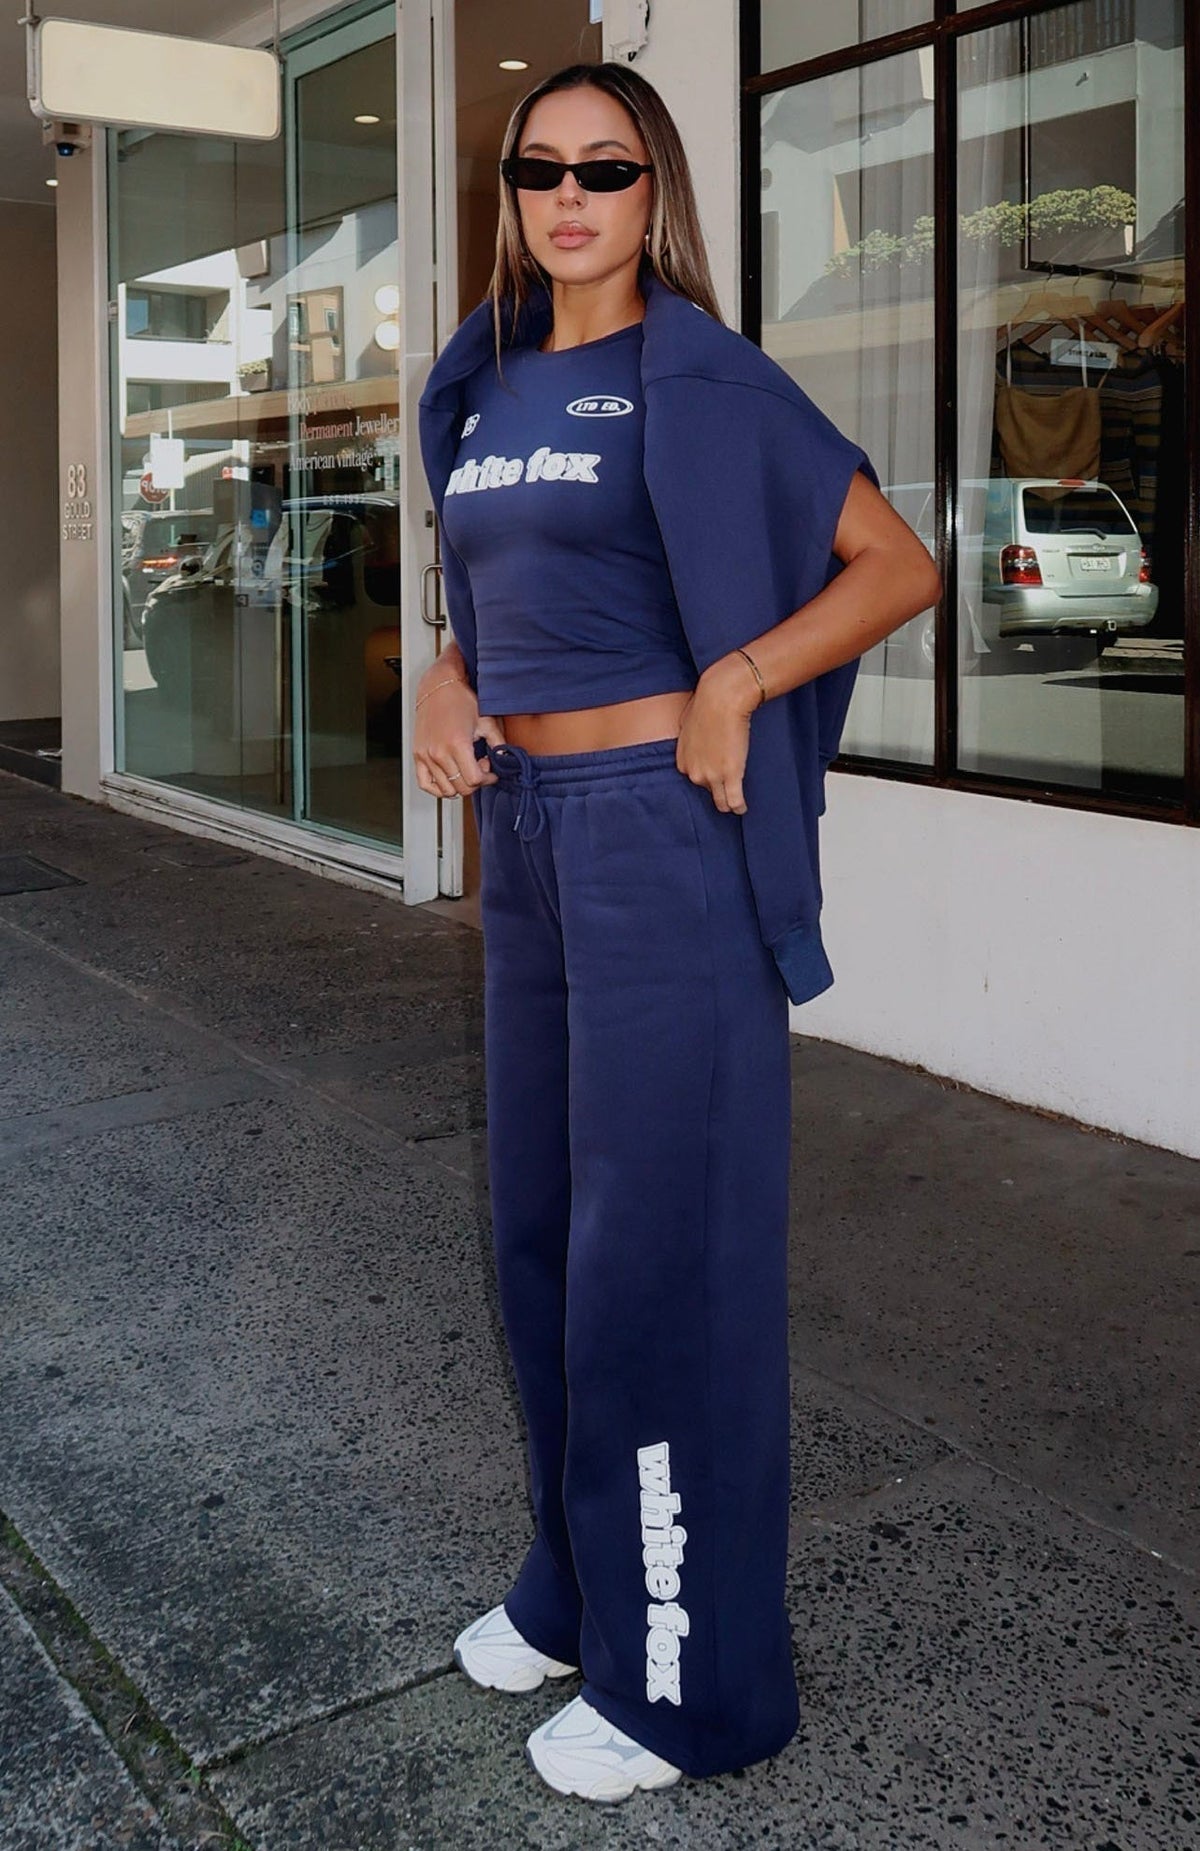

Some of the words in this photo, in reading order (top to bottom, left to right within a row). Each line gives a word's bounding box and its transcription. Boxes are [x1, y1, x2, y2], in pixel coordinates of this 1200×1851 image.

[575, 401, 598, 412] LTD
[300, 421, 353, 440] Permanent
[355, 412, 400, 436] Jeweller
[288, 451, 335, 472] American
[525, 446, 601, 483] fox
[68, 464, 86, 498] 83
[62, 523, 92, 541] STREET
[636, 1441, 688, 1600] white
[646, 1602, 690, 1706] fox
